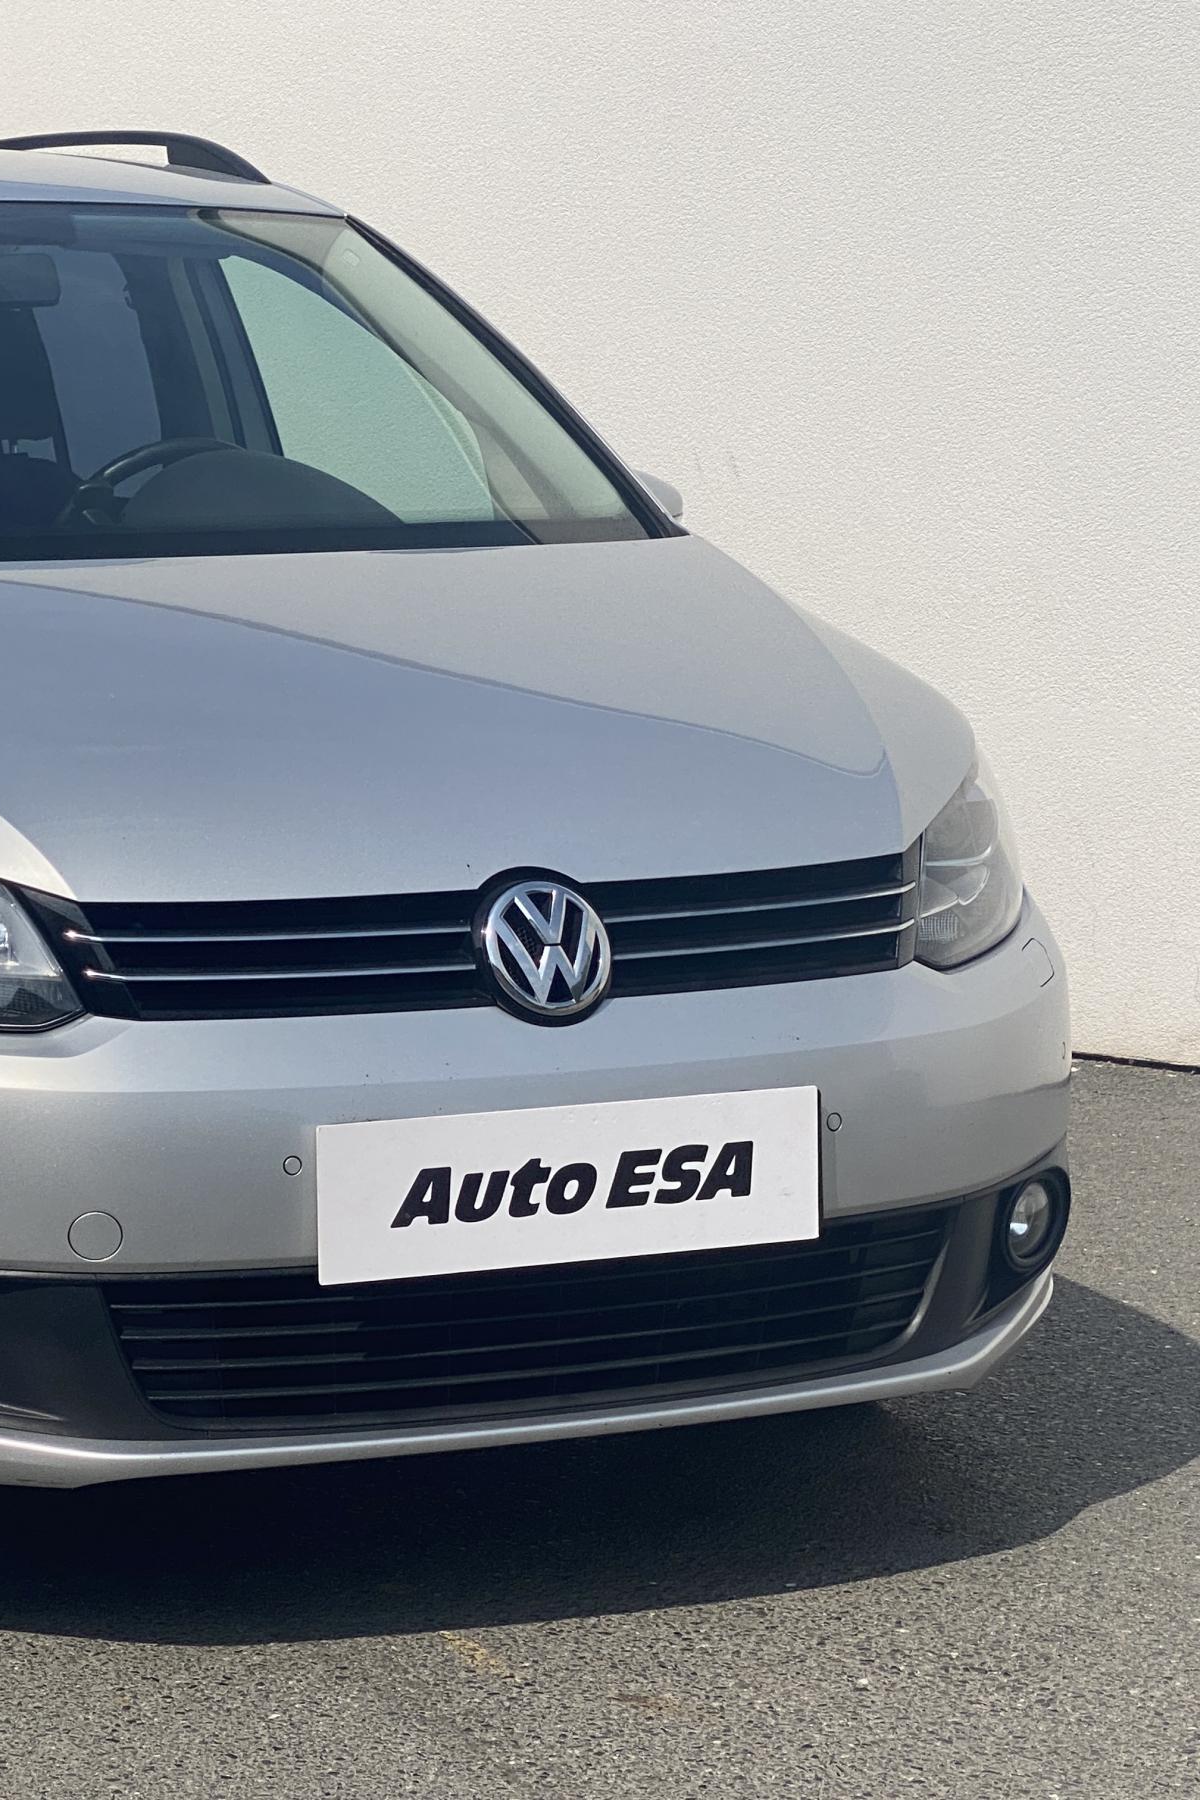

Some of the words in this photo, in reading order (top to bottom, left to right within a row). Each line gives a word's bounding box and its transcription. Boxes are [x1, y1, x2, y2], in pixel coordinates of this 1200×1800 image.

[490, 884, 607, 1011] VW
[390, 1157, 598, 1229] Auto
[605, 1140, 754, 1209] ESA
